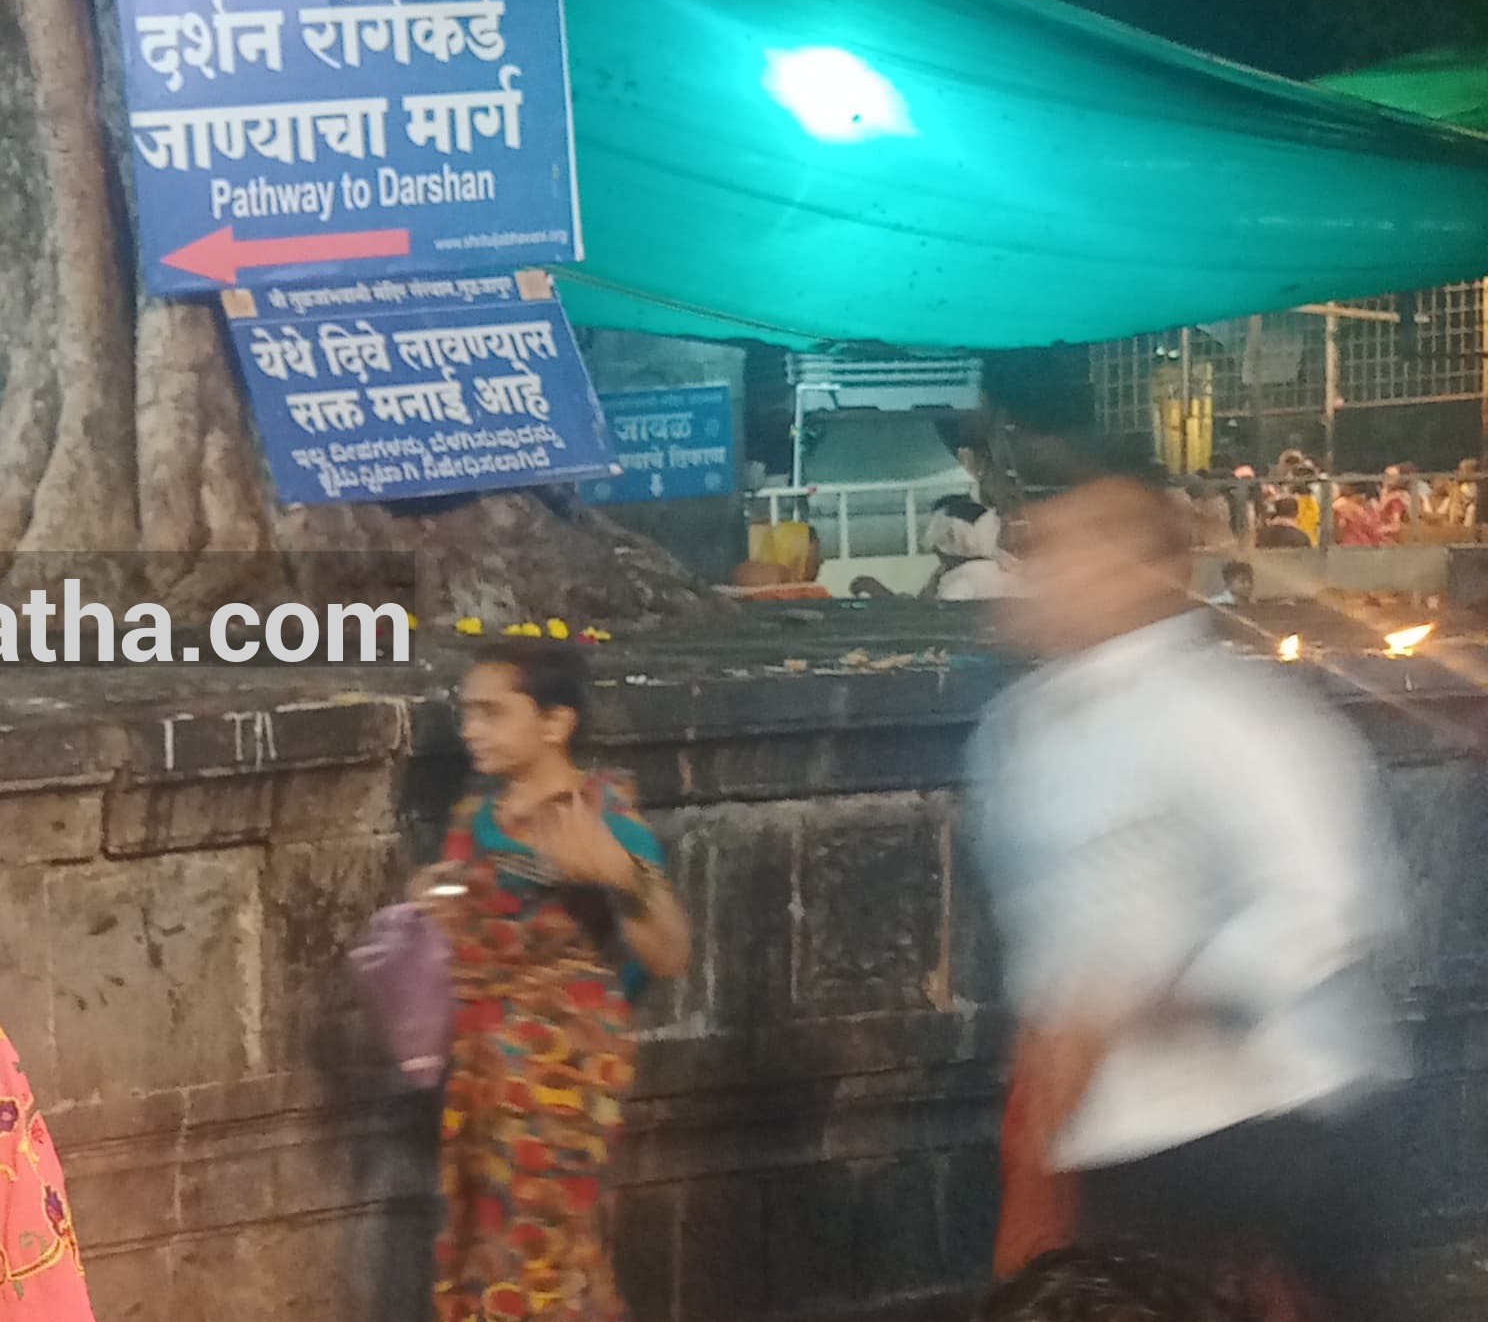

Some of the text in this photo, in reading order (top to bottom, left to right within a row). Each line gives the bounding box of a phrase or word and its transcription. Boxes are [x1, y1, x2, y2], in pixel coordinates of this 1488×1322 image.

[130, 65, 523, 171] जाण्याचा मार्ग
[212, 164, 495, 222] Pathway to Darshan
[250, 320, 558, 383] येथे दिवे लावण्यास
[287, 363, 551, 434] सक्त मनाई आहे
